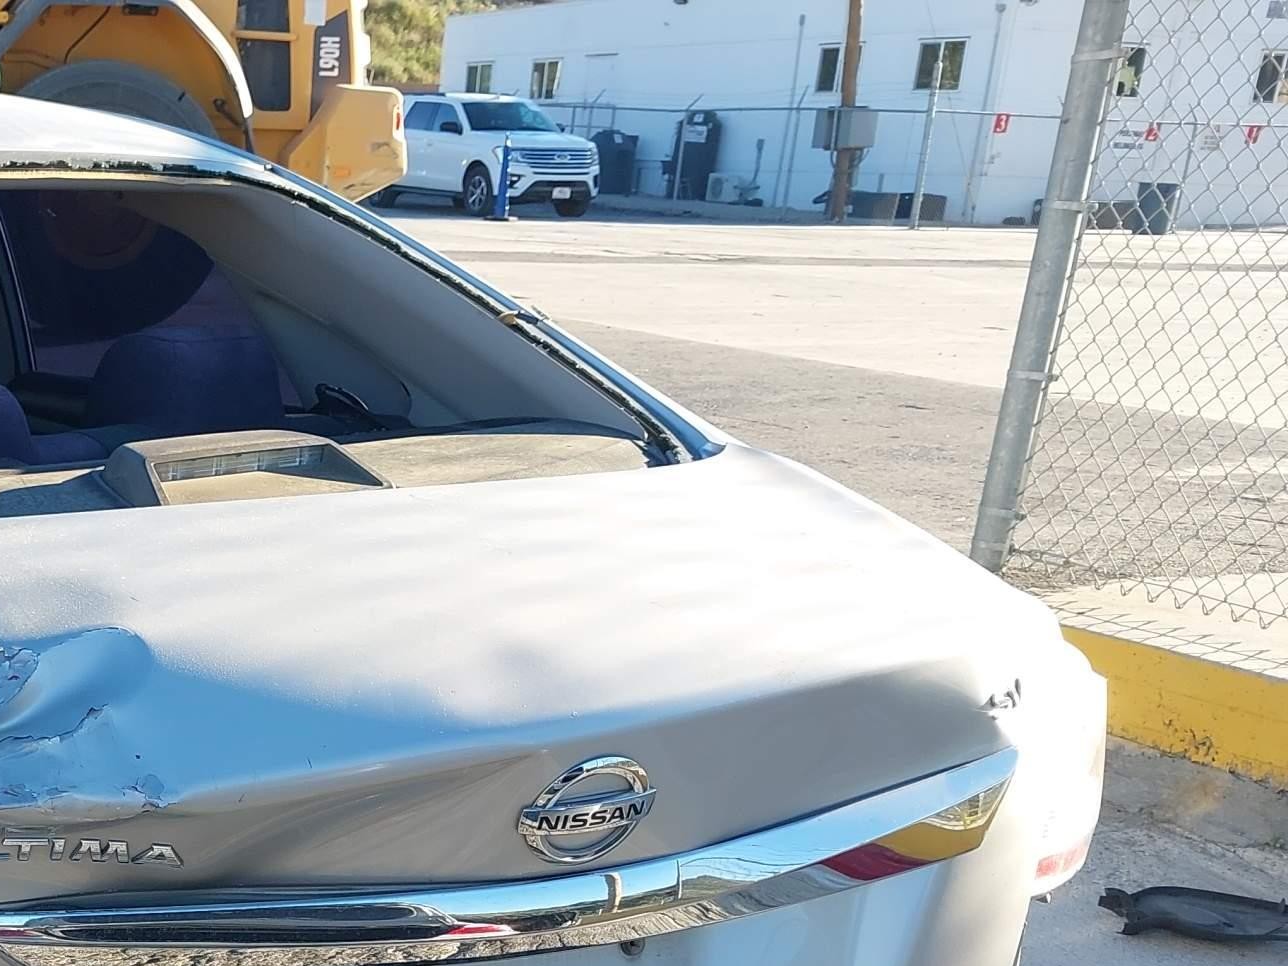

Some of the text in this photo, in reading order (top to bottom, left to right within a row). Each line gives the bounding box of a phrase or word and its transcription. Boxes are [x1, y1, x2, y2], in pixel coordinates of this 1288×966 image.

[318, 36, 341, 77] L90H
[996, 115, 1007, 132] 3
[536, 800, 645, 831] NISSAN
